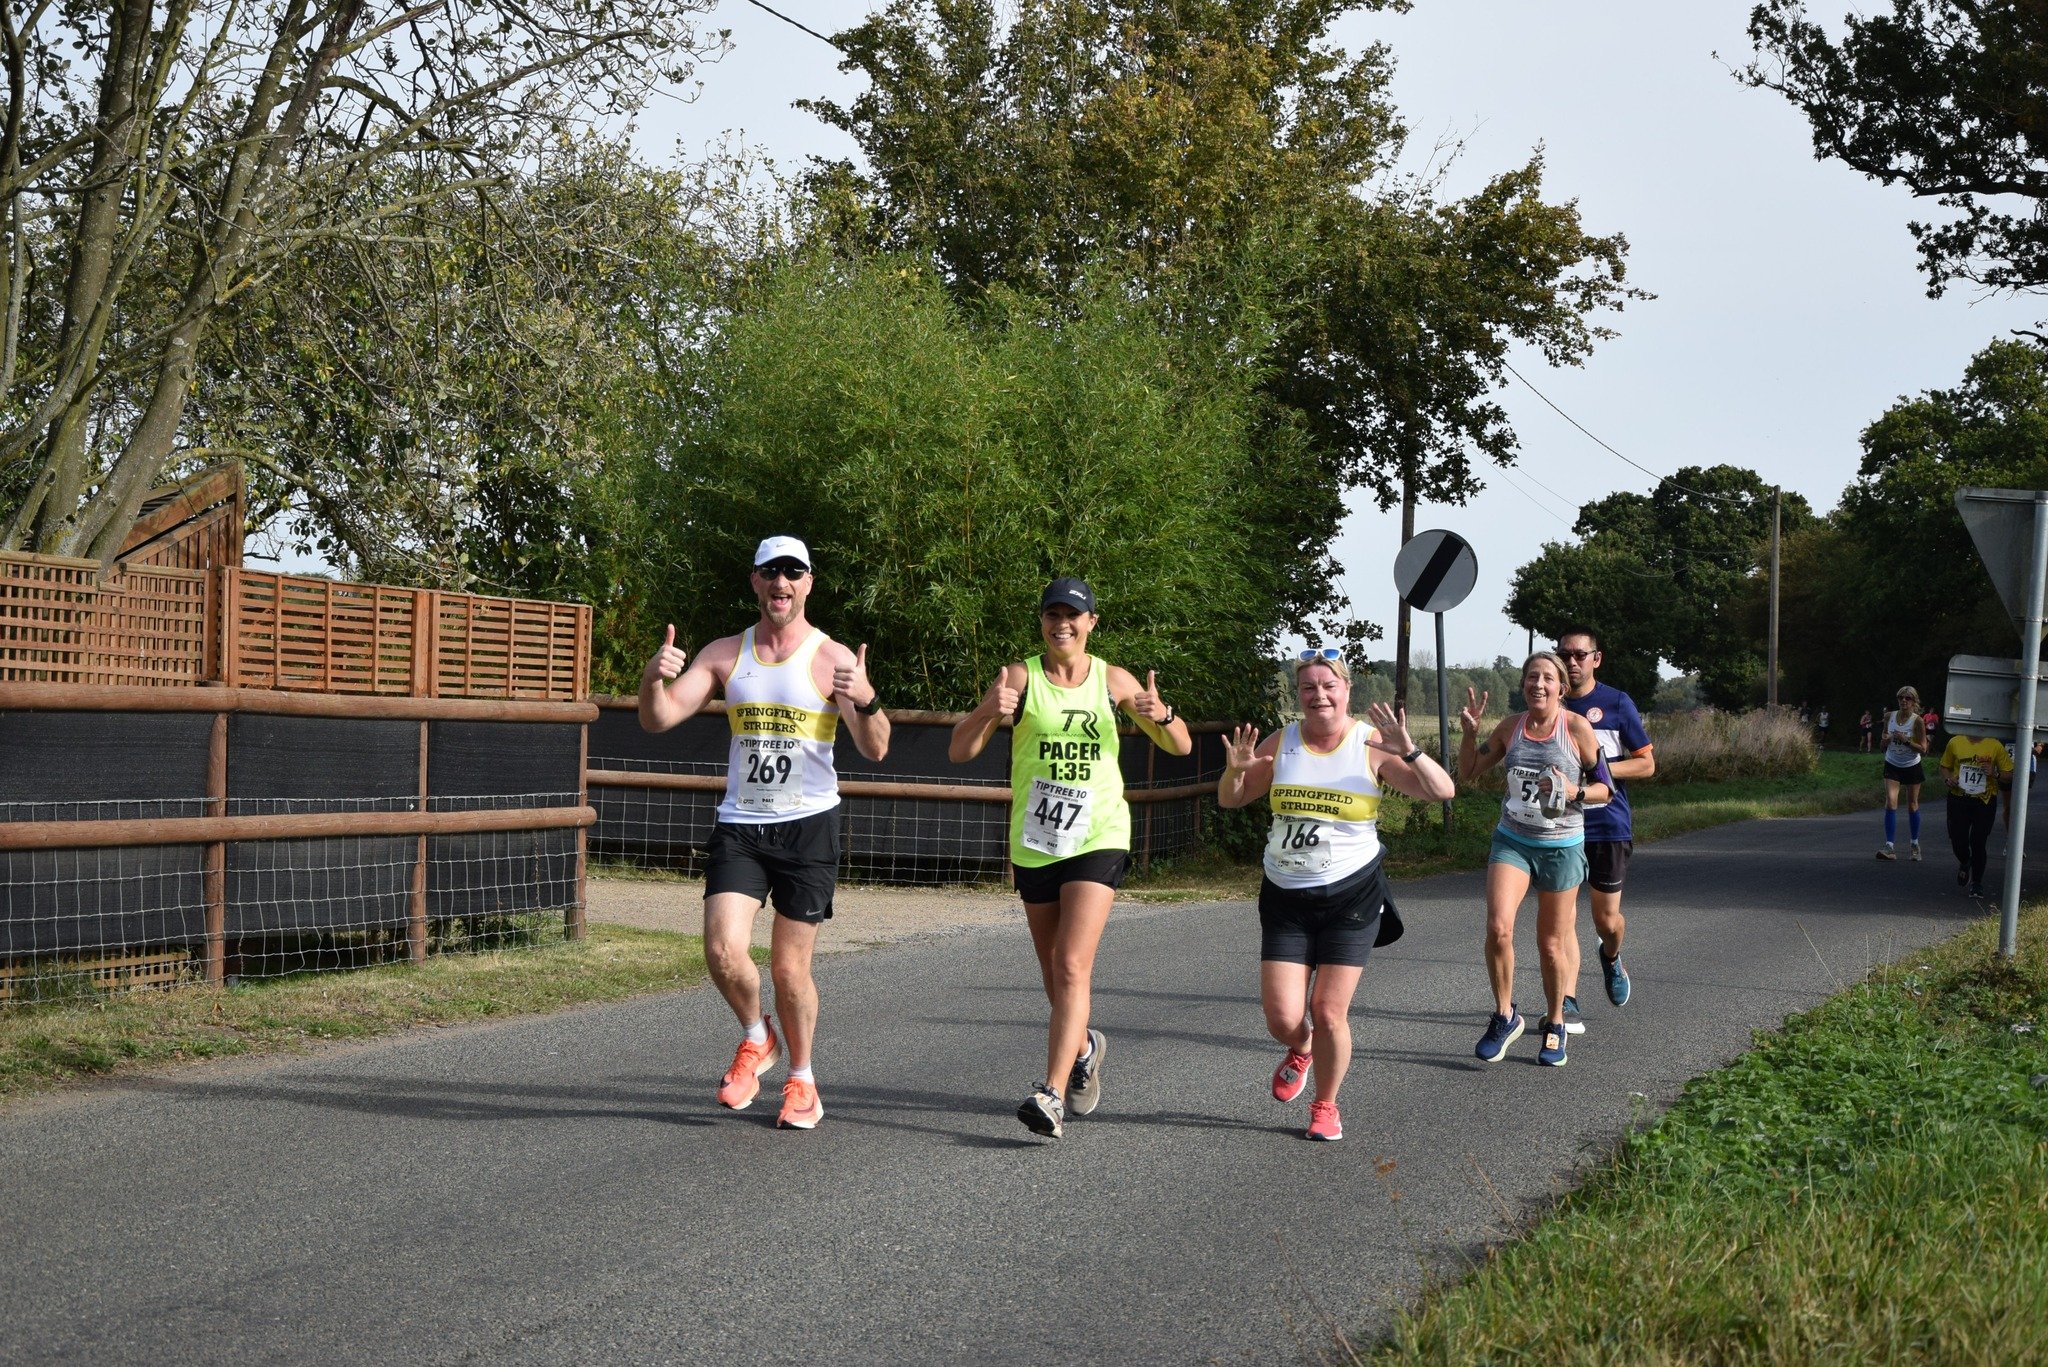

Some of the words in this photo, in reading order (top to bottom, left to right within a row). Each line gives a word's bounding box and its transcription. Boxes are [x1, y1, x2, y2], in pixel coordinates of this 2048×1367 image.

[737, 707, 807, 722] SPRINGFIELD
[743, 721, 796, 734] STRIDERS
[743, 739, 781, 749] TIPTREE
[784, 740, 795, 749] 10
[1039, 741, 1101, 761] PACER
[746, 753, 792, 785] 269
[1048, 762, 1091, 781] 1:35
[1964, 771, 1984, 784] 147
[1035, 780, 1075, 798] TIPTREE
[1076, 790, 1088, 799] 10
[1273, 788, 1354, 805] SPRINGFIELD
[1034, 797, 1083, 831] 447
[1280, 801, 1340, 815] STRIDERS
[1281, 823, 1321, 850] 166
